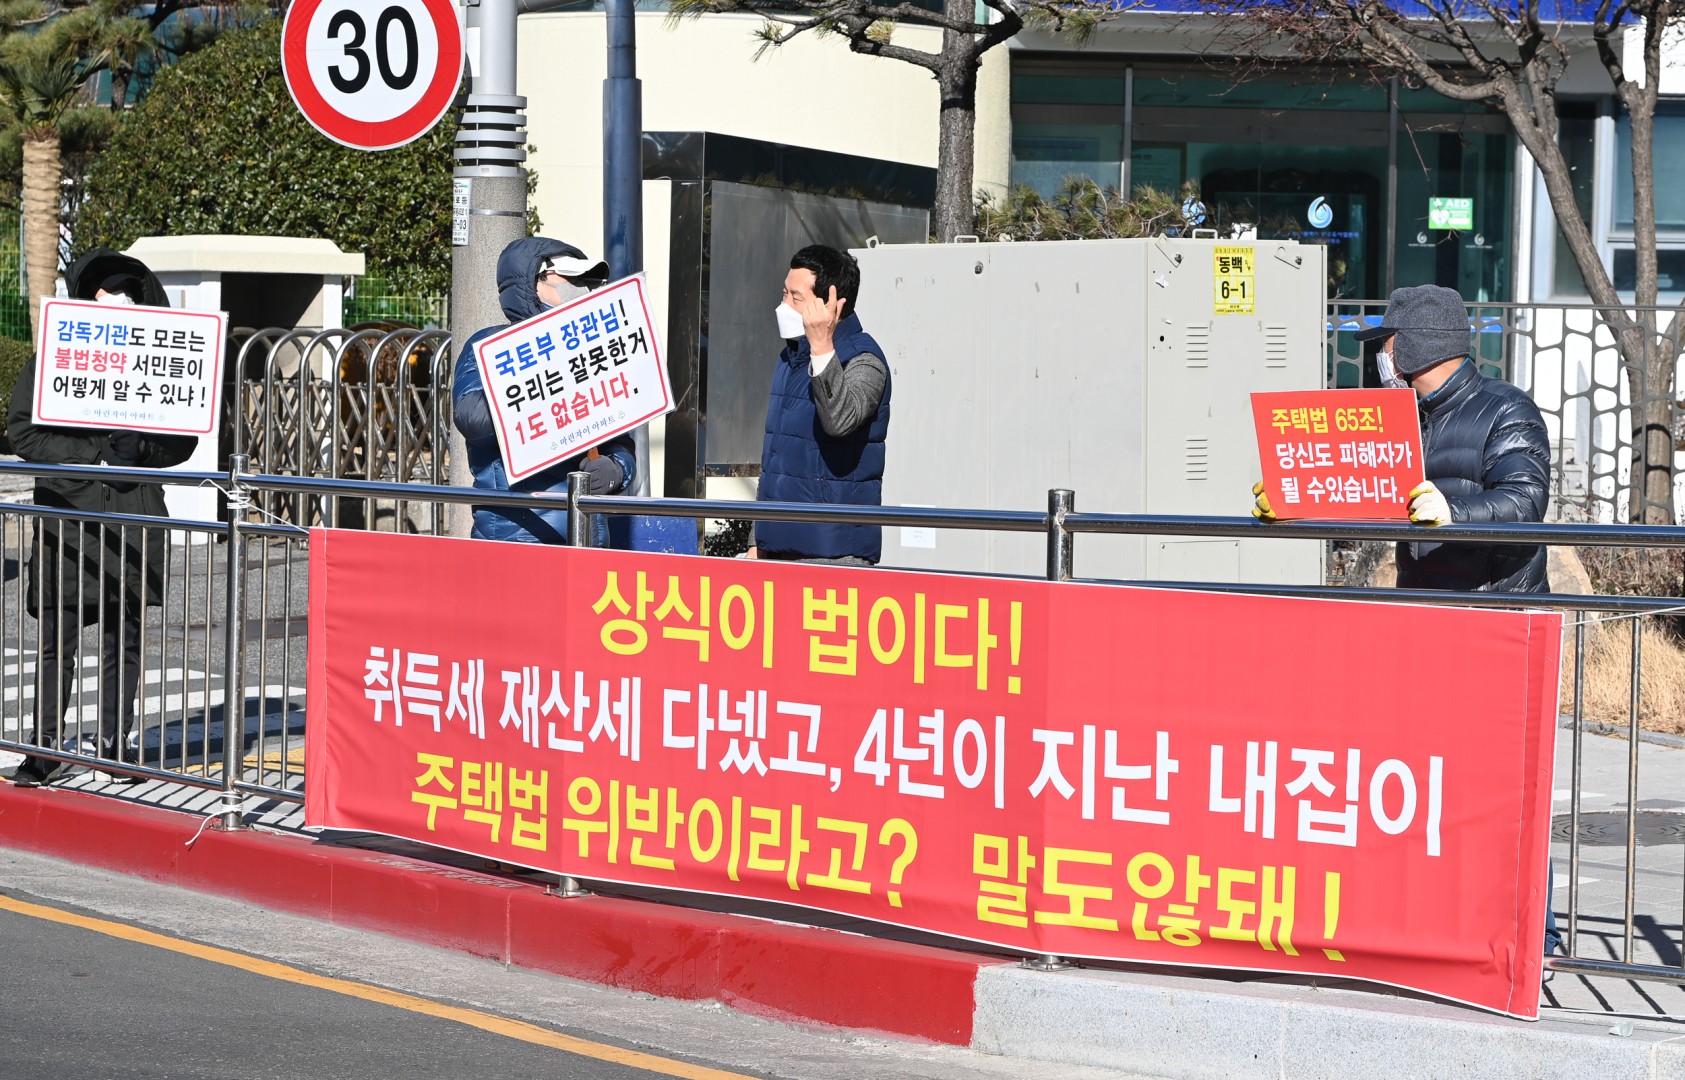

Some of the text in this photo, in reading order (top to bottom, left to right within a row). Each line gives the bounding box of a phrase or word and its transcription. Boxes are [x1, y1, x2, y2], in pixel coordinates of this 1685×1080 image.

[327, 5, 419, 94] 30
[1445, 199, 1470, 208] AED
[1219, 256, 1243, 273] 동백
[1221, 280, 1246, 299] 6-1
[57, 320, 206, 352] 감독기관도 모르는
[494, 299, 629, 377] 국토부 장관님!
[54, 347, 203, 380] 불법청약 서민들이
[505, 326, 649, 413] 우리는 잘못한거
[53, 376, 106, 400] 어떻게
[112, 379, 130, 402] 알
[135, 382, 153, 404] 수
[93, 409, 155, 421] 마린자이 아파트
[515, 371, 639, 445] 1도 없습니다.
[1271, 405, 1384, 434] 주택법 65조!
[559, 415, 617, 446] 마린자이 아파트
[1275, 440, 1413, 469] 당신도 피해자가
[1280, 475, 1405, 504] 될 수있습니다.
[591, 570, 1023, 695] 상식이 법이다!
[363, 645, 1445, 857] 취득세 재산세 다넸고, 4년이 지난 내집이
[411, 752, 549, 852] 주택법
[562, 776, 918, 908] 위반이라고?
